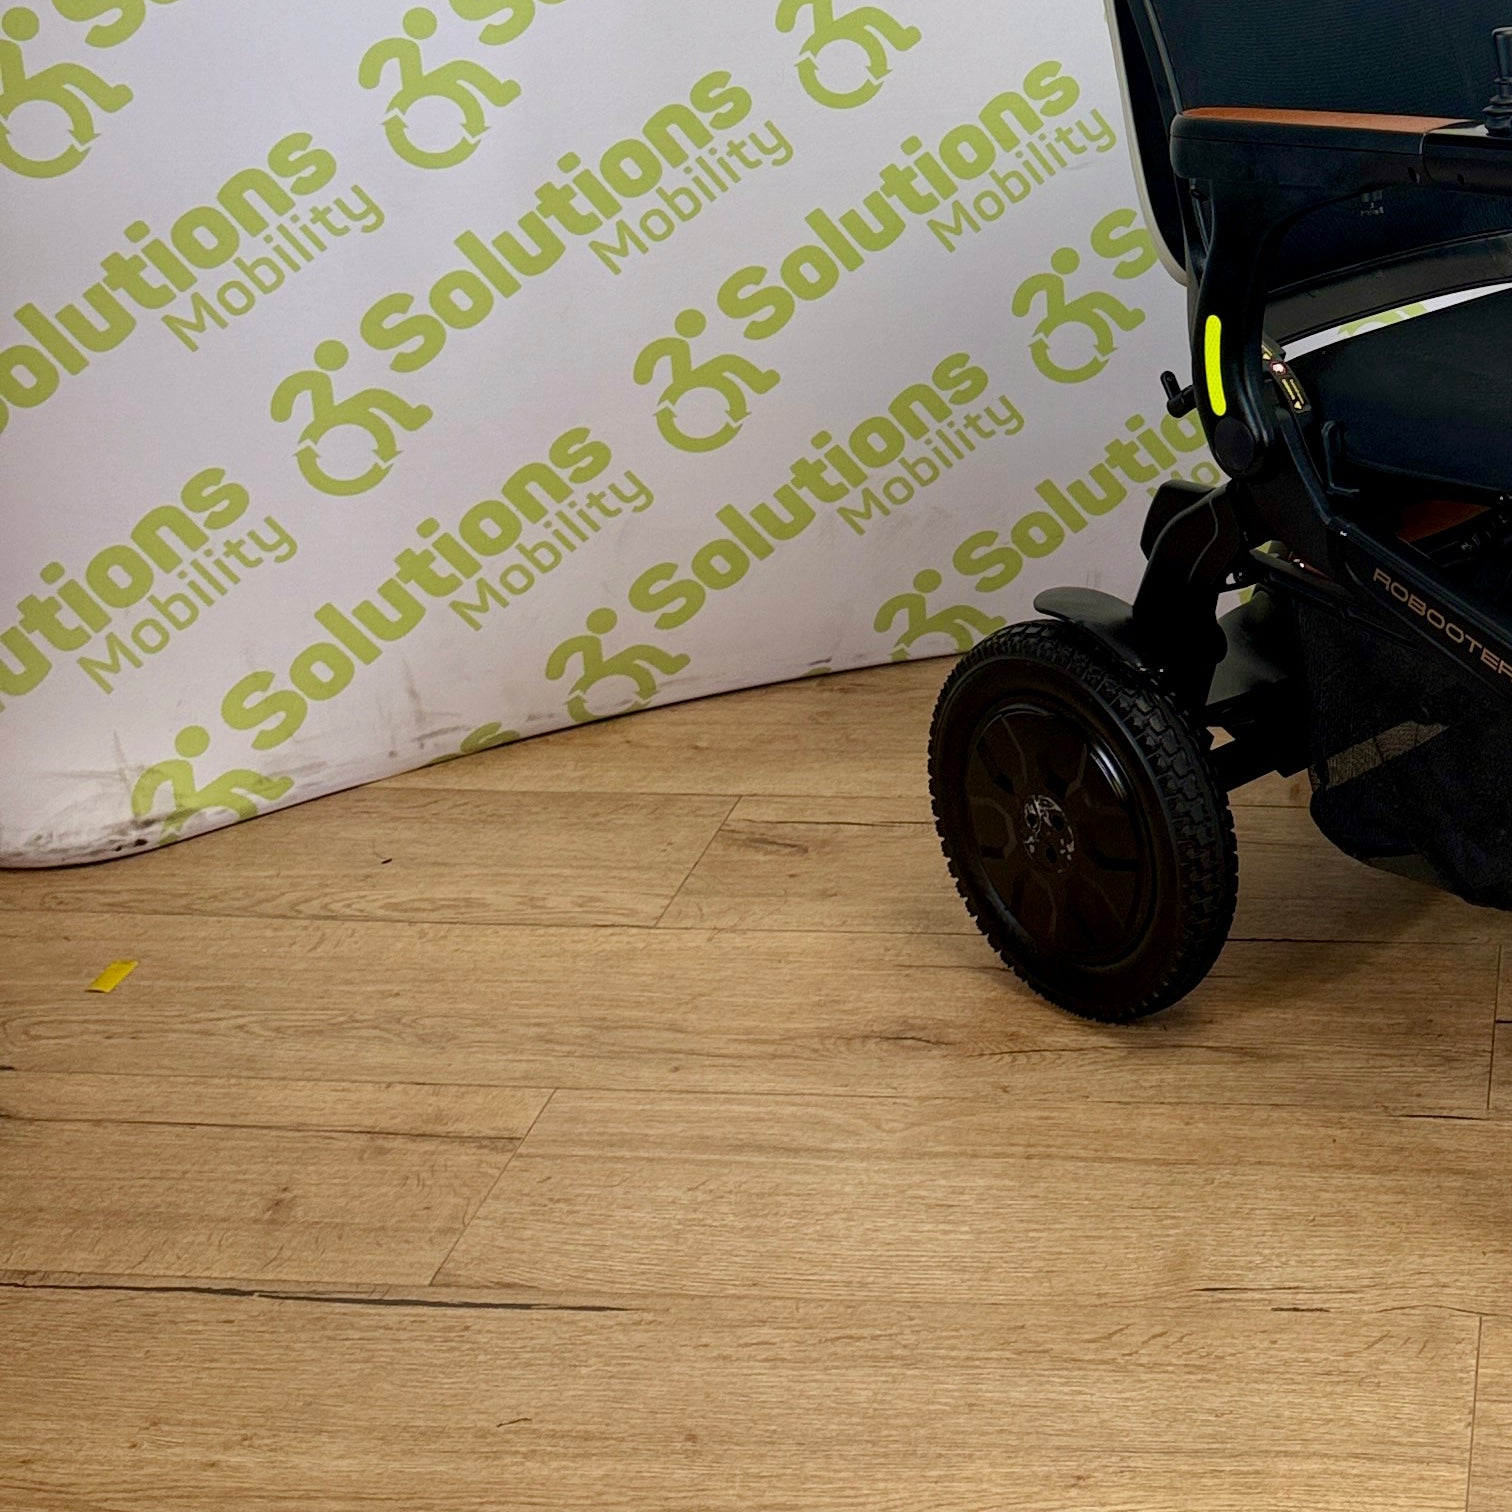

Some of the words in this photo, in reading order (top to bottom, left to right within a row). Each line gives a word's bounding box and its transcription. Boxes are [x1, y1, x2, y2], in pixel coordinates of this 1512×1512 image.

[0, 131, 337, 434] olutions
[162, 185, 386, 353] Mobility
[359, 70, 753, 374] Solutions
[587, 119, 794, 275] Mobility
[717, 59, 1081, 341] Solutions
[926, 108, 1117, 253] Mobility
[448, 469, 655, 632] Mobility
[628, 352, 990, 631] Solutions
[837, 394, 1026, 536] Mobility
[0, 467, 250, 712] utions
[75, 515, 298, 695] Mobility
[220, 427, 612, 751] Solutions
